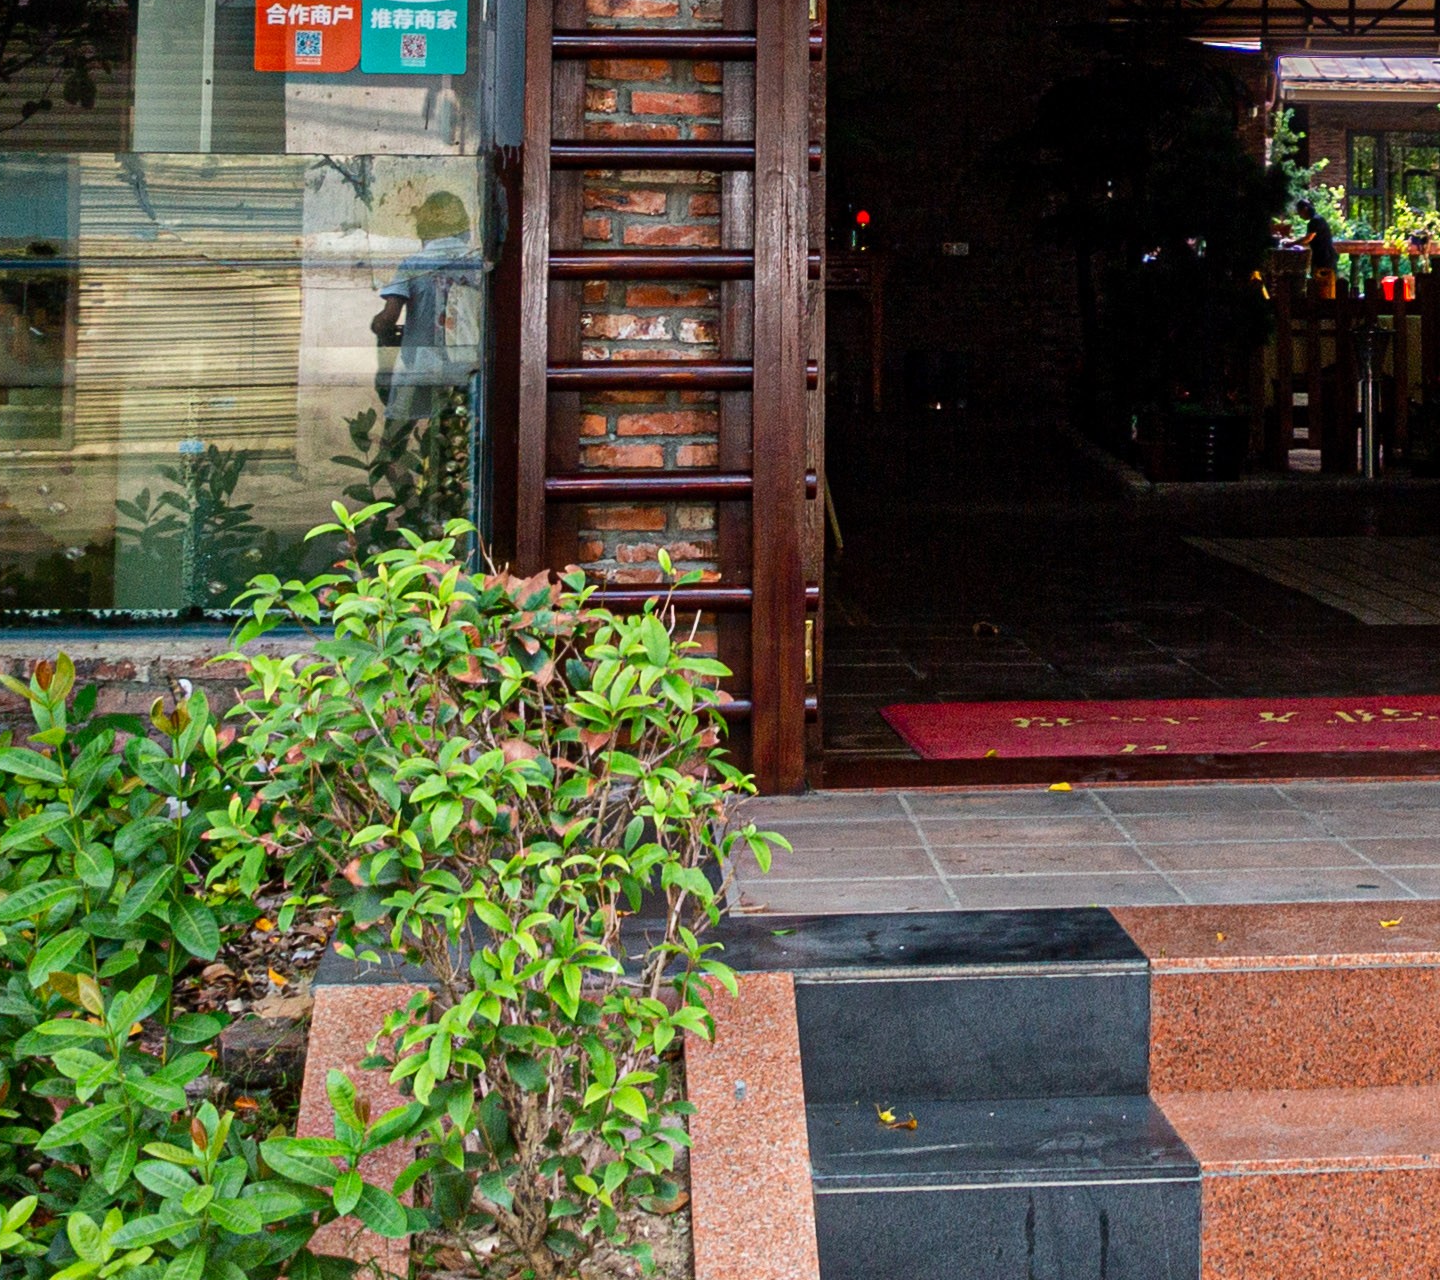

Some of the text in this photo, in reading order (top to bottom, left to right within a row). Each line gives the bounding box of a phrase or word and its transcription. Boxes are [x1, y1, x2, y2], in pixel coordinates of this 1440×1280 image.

[266, 3, 354, 25] 合作商户
[370, 8, 458, 30] 推荐商家
